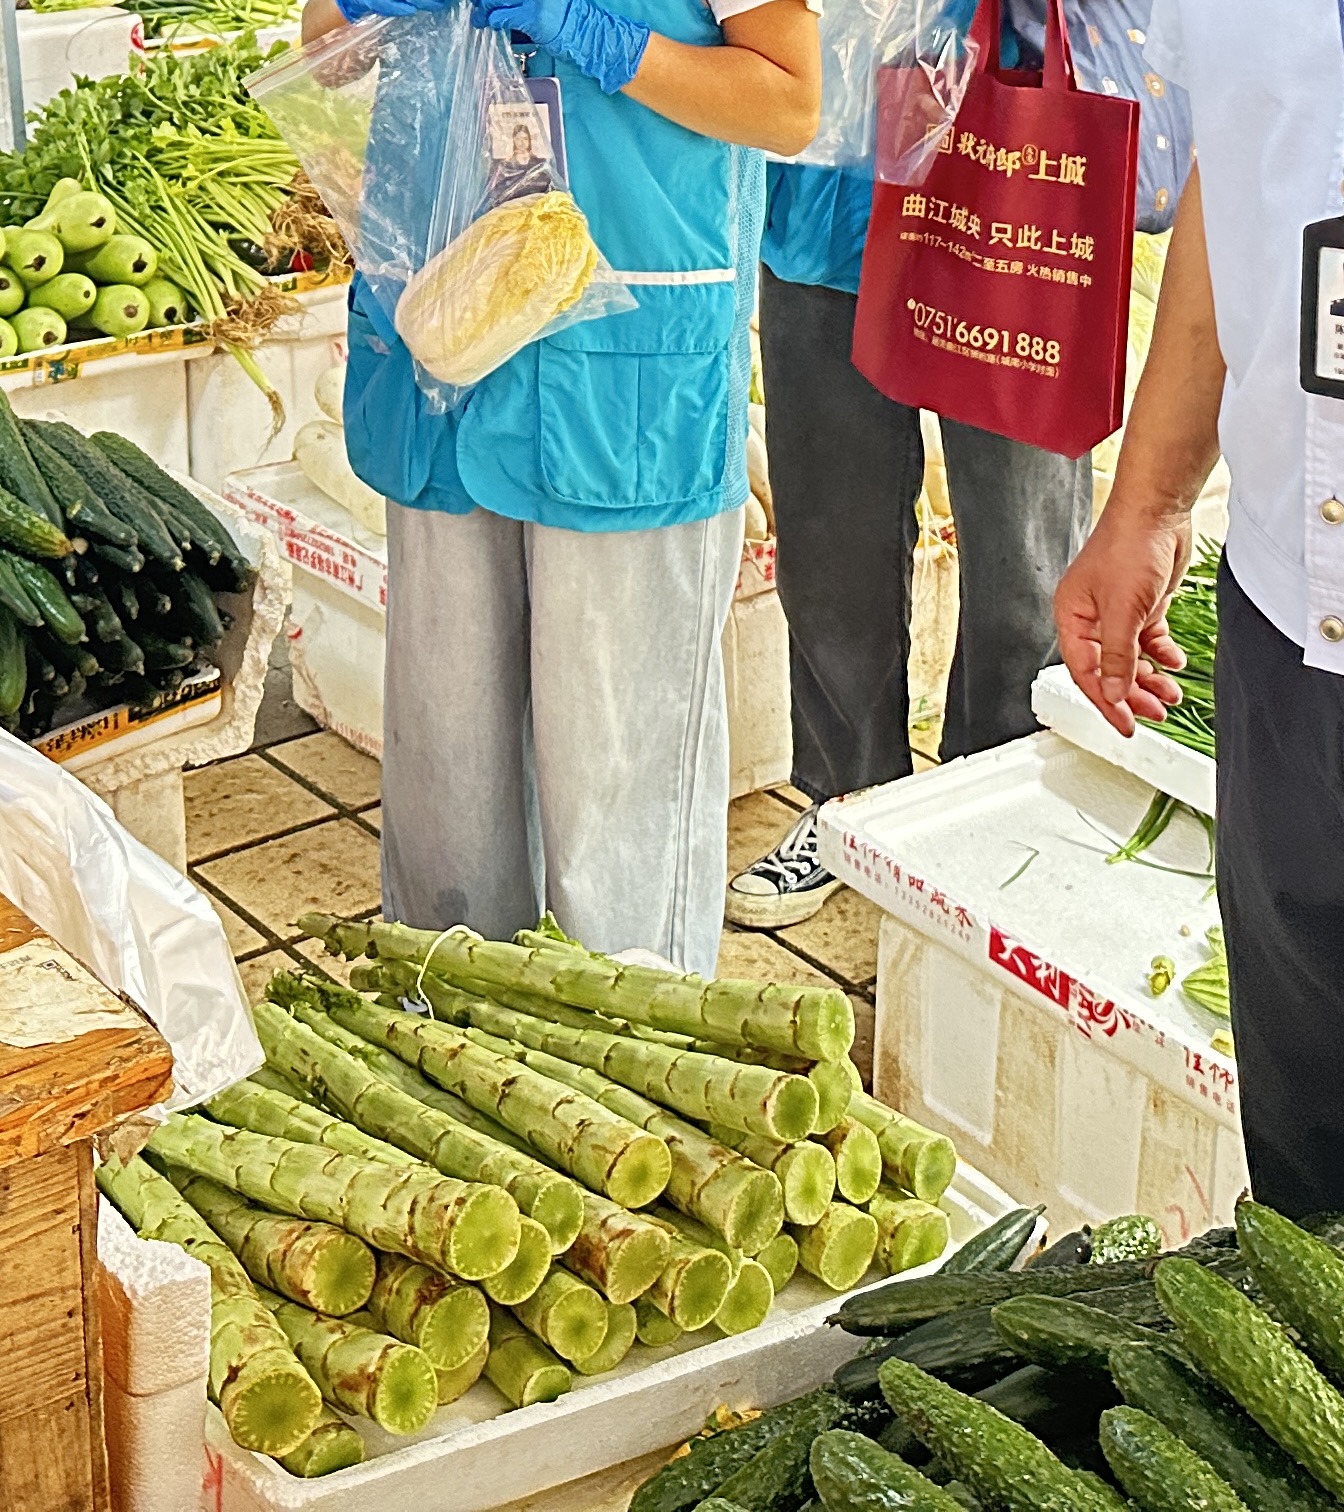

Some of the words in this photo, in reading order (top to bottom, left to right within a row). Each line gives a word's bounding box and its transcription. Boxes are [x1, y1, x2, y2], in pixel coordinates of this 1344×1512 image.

[902, 193, 982, 239] 曲江城央
[988, 222, 1095, 262] 只此上城
[1026, 262, 1093, 289] 火热销售中
